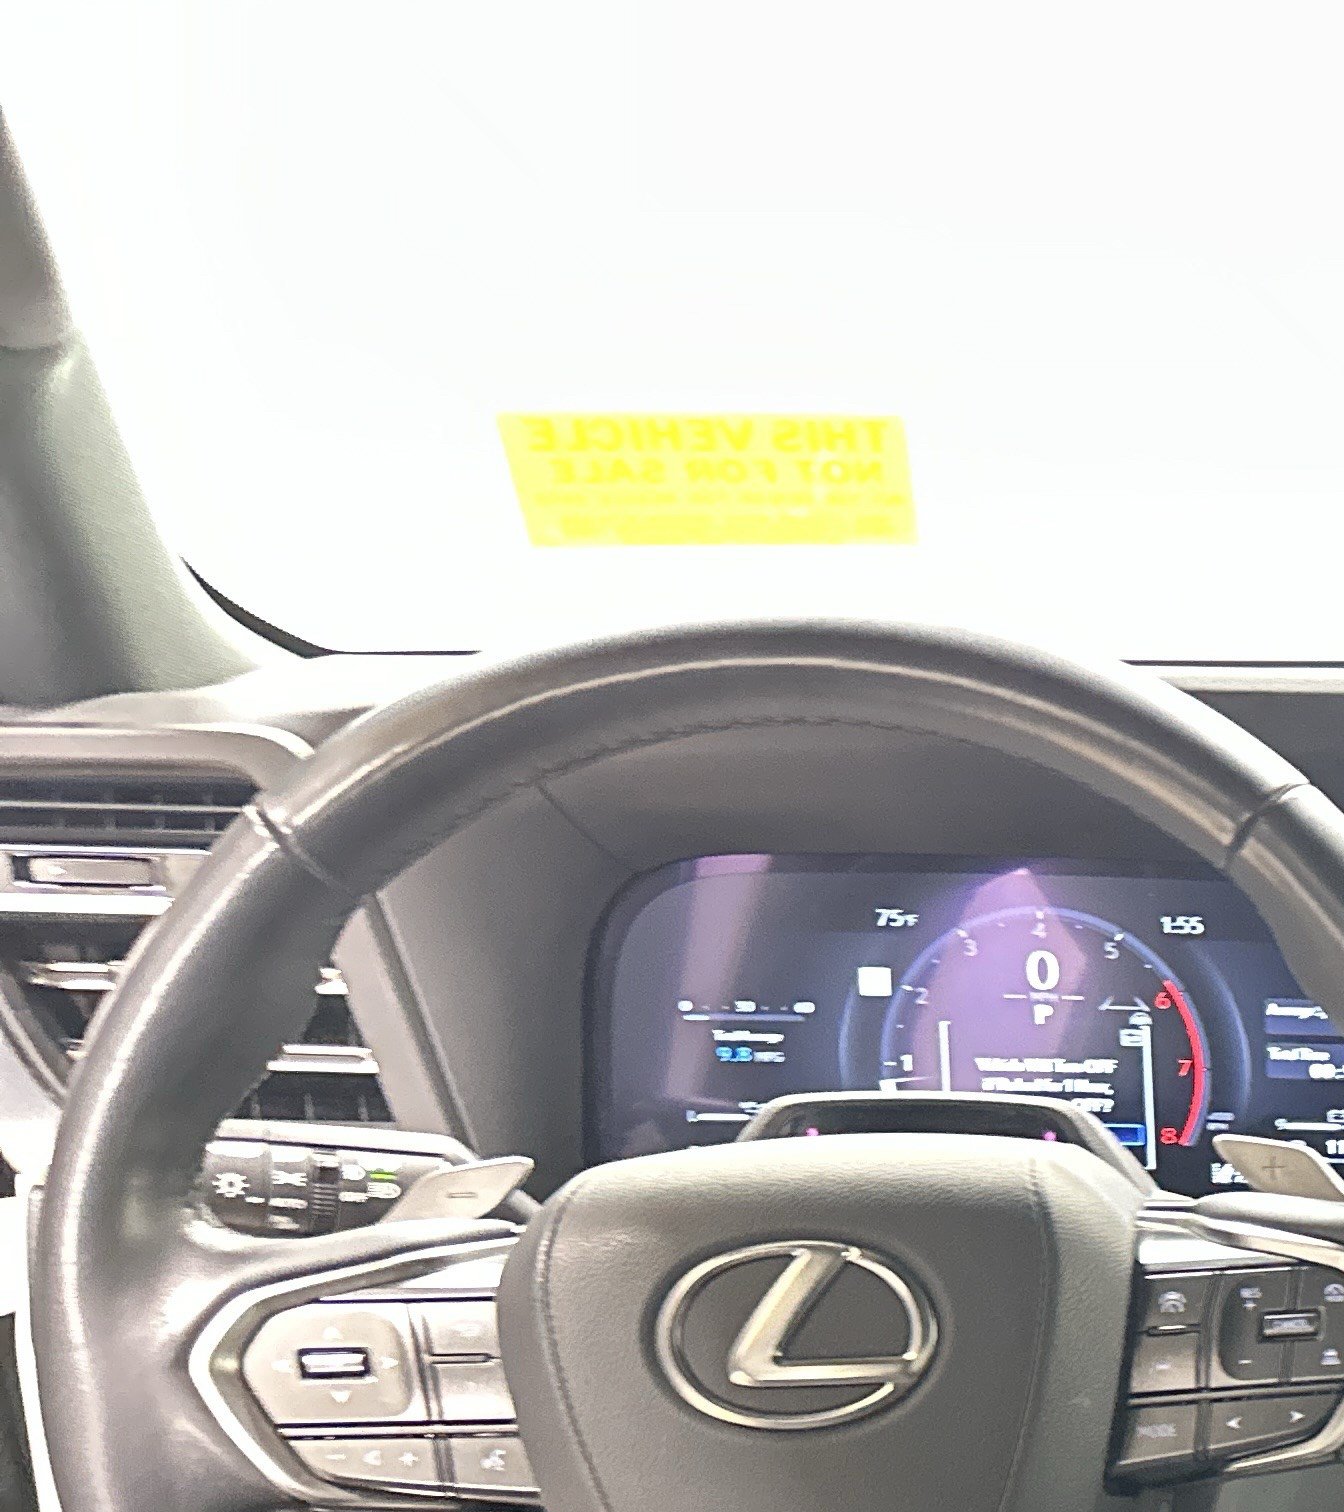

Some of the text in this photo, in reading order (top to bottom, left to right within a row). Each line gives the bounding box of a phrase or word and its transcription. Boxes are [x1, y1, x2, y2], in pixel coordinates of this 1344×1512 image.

[963, 939, 978, 957] 3
[1104, 941, 1120, 960] 5
[1025, 950, 1060, 991] 0
[916, 987, 929, 1004] 2
[1154, 992, 1172, 1010] 6
[1033, 1004, 1055, 1025] P
[899, 1054, 914, 1072] 1
[1177, 1059, 1194, 1076] 7
[1160, 1127, 1177, 1145] 8
